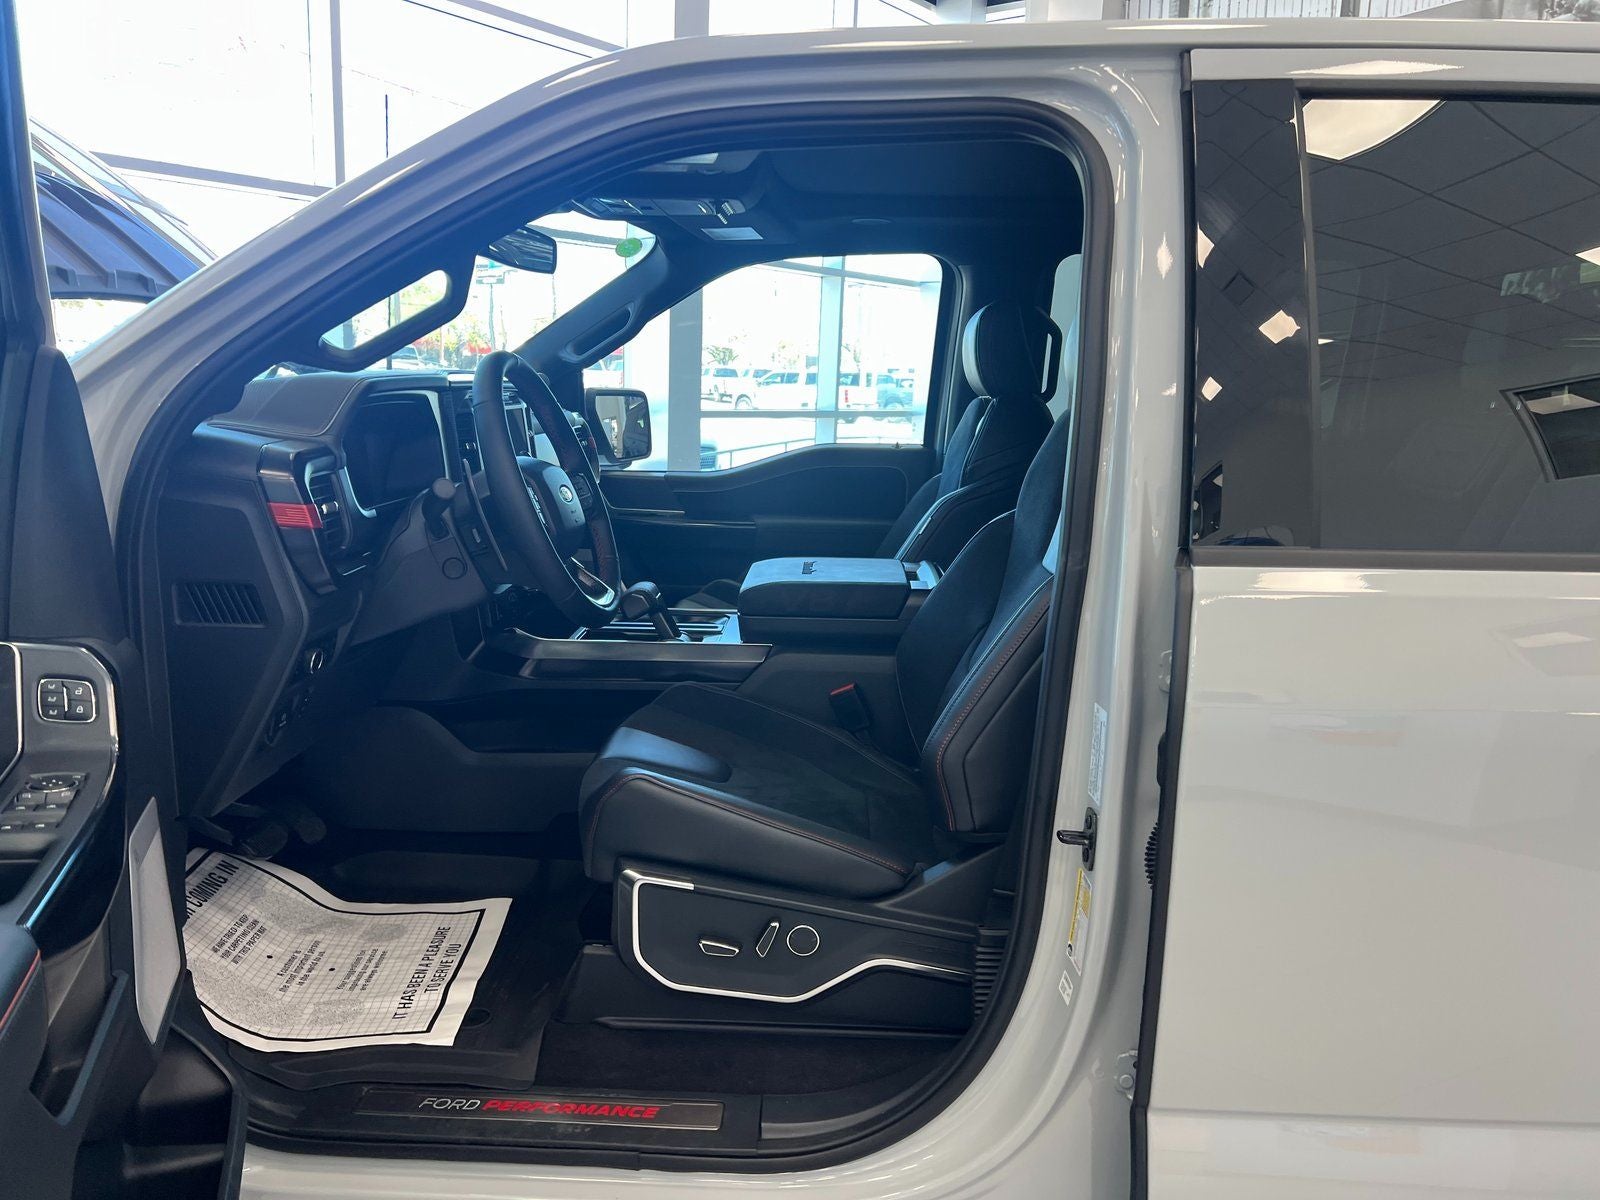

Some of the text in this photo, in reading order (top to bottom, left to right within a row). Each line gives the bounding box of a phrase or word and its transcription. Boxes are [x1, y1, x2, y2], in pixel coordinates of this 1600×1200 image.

[186, 860, 239, 907] COMING IN
[223, 926, 238, 940] TRIED
[228, 929, 251, 951] CARPETING
[245, 932, 261, 947] PAPER
[421, 926, 451, 961] PLEASURE
[406, 969, 429, 988] BEEN
[424, 943, 462, 994] TO SERVE YOU
[397, 989, 417, 1010] HAS
[391, 1011, 408, 1020] IT
[418, 1097, 660, 1118] FORD PERFORMANCE
